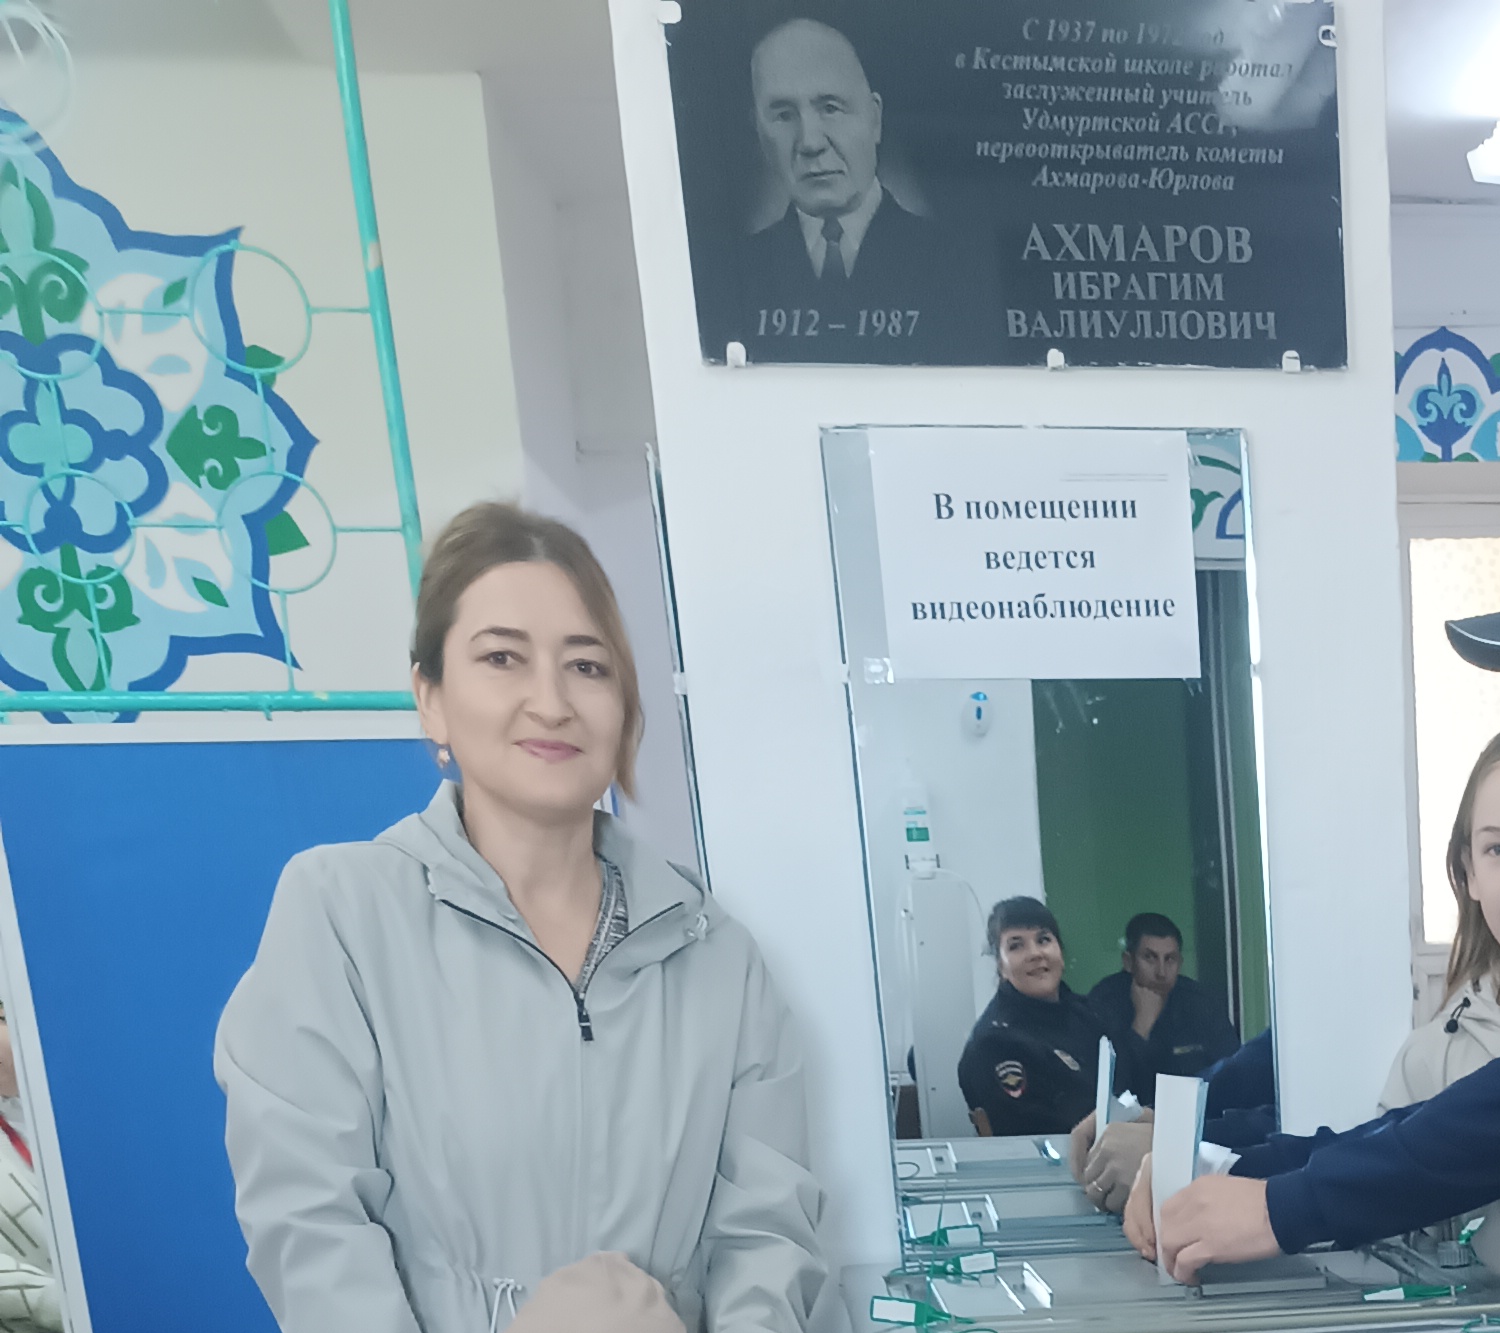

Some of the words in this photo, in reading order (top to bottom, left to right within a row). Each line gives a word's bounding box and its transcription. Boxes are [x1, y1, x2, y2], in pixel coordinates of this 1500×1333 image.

[1022, 18, 1040, 41] С
[1047, 18, 1096, 43] 1937
[1101, 27, 1128, 44] по
[954, 52, 966, 69] в
[972, 46, 1117, 74] Кестымской
[1124, 57, 1194, 76] школе
[1002, 81, 1155, 106] заслуженный
[1022, 106, 1160, 137] Удмуртской
[975, 140, 1190, 166] первооткрыватель
[1195, 146, 1284, 165] кометы
[1031, 164, 1235, 196] Ахмарова-Юрлова
[1021, 222, 1254, 264] АХМАРОВ
[1053, 270, 1225, 301] ИБРАГИМ
[757, 308, 821, 337] 1912
[857, 308, 920, 338] 1987
[1006, 308, 1278, 341] ВАЛИУЛЛОВИЧ
[933, 492, 955, 521] В
[965, 496, 1138, 523] помещении
[984, 548, 1097, 572] ведется
[911, 593, 1177, 622] видеонаблюдение
